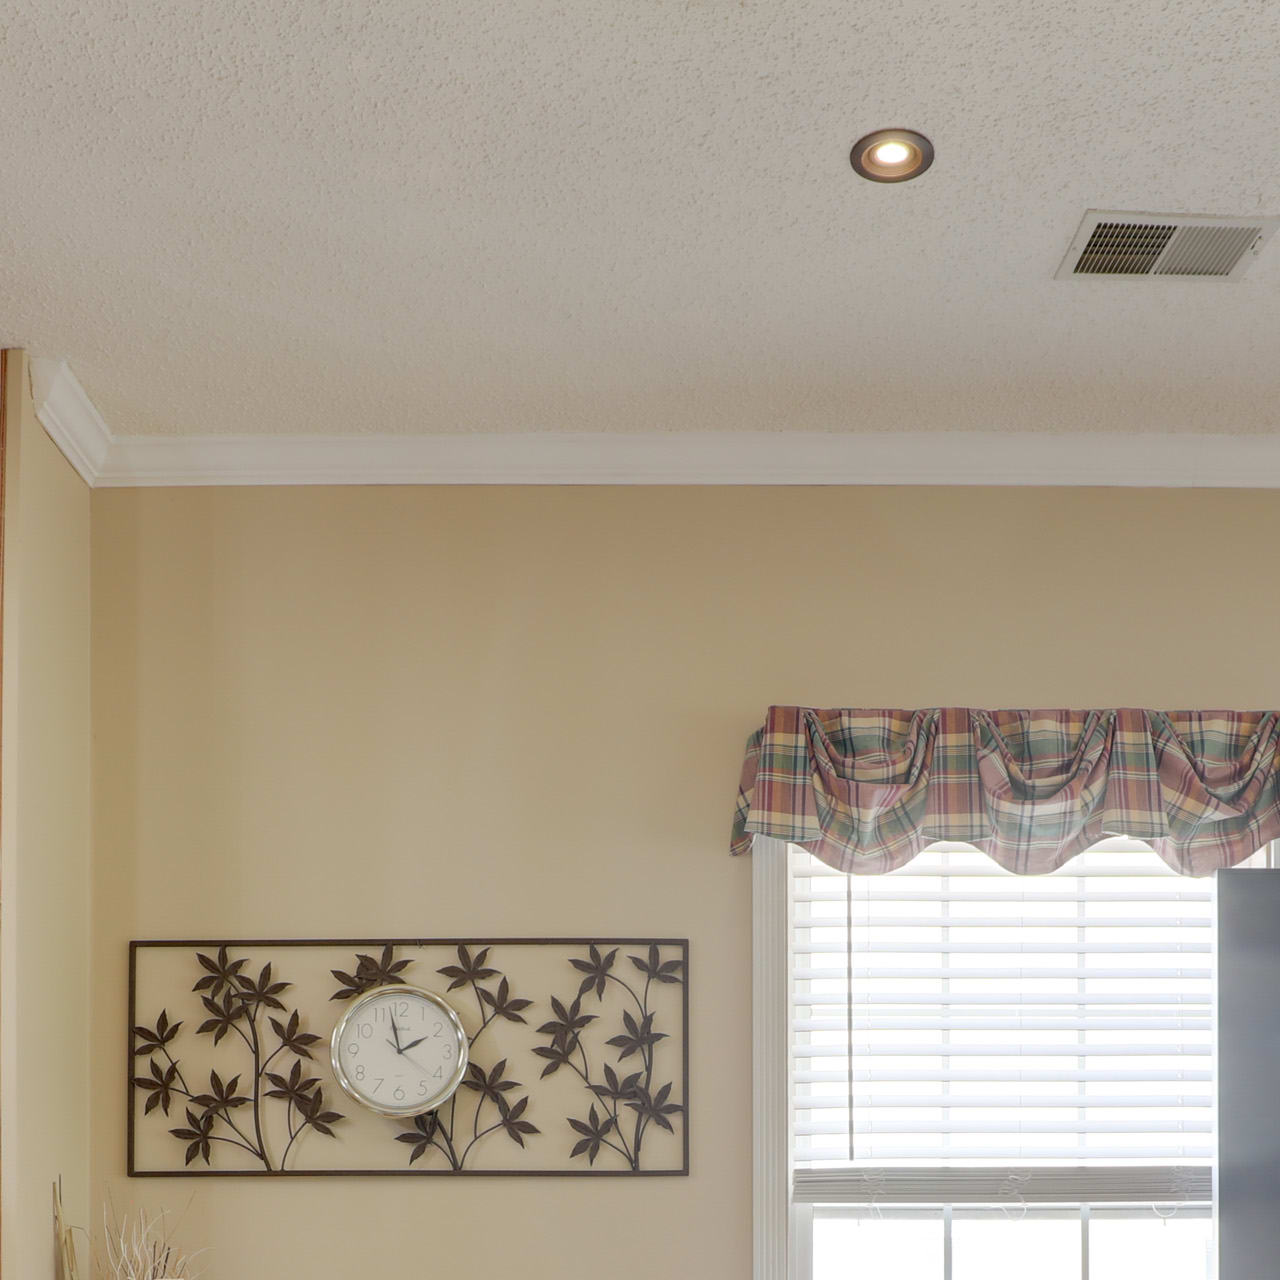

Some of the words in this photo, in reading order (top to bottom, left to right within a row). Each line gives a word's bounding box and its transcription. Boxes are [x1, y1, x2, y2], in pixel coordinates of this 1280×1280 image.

[373, 1007, 386, 1023] 11
[393, 1001, 410, 1018] 12
[356, 1023, 374, 1040] 10
[432, 1021, 444, 1038] 2
[347, 1042, 360, 1058] 9
[442, 1044, 452, 1060] 3
[354, 1064, 366, 1081] 8
[431, 1065, 443, 1080] 4
[372, 1078, 385, 1095] 7
[392, 1086, 406, 1101] 6
[417, 1080, 428, 1097] 5
